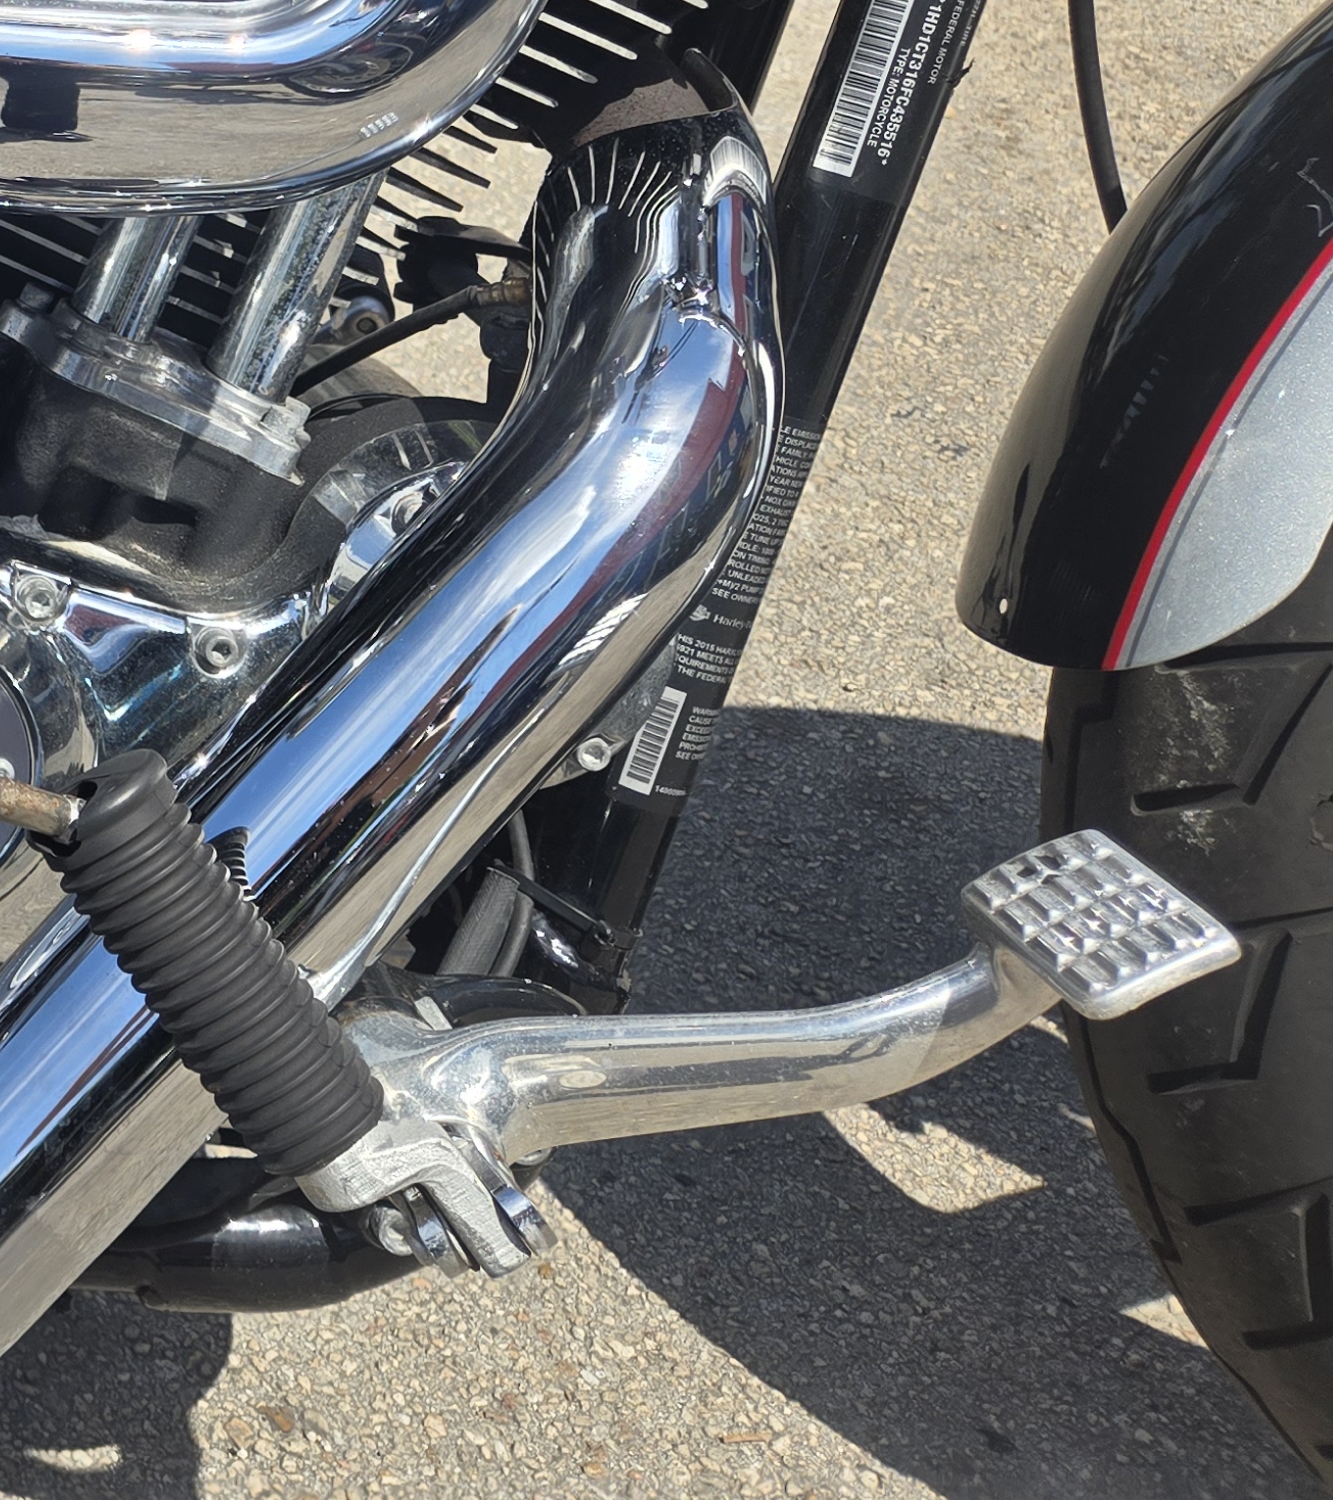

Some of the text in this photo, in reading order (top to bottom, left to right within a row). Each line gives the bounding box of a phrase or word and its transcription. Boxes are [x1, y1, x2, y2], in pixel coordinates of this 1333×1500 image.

[941, 0, 964, 44] FEDERAL
[927, 47, 947, 84] MOTOR
[867, 48, 910, 146] TYPE: MOTORCYCLE
